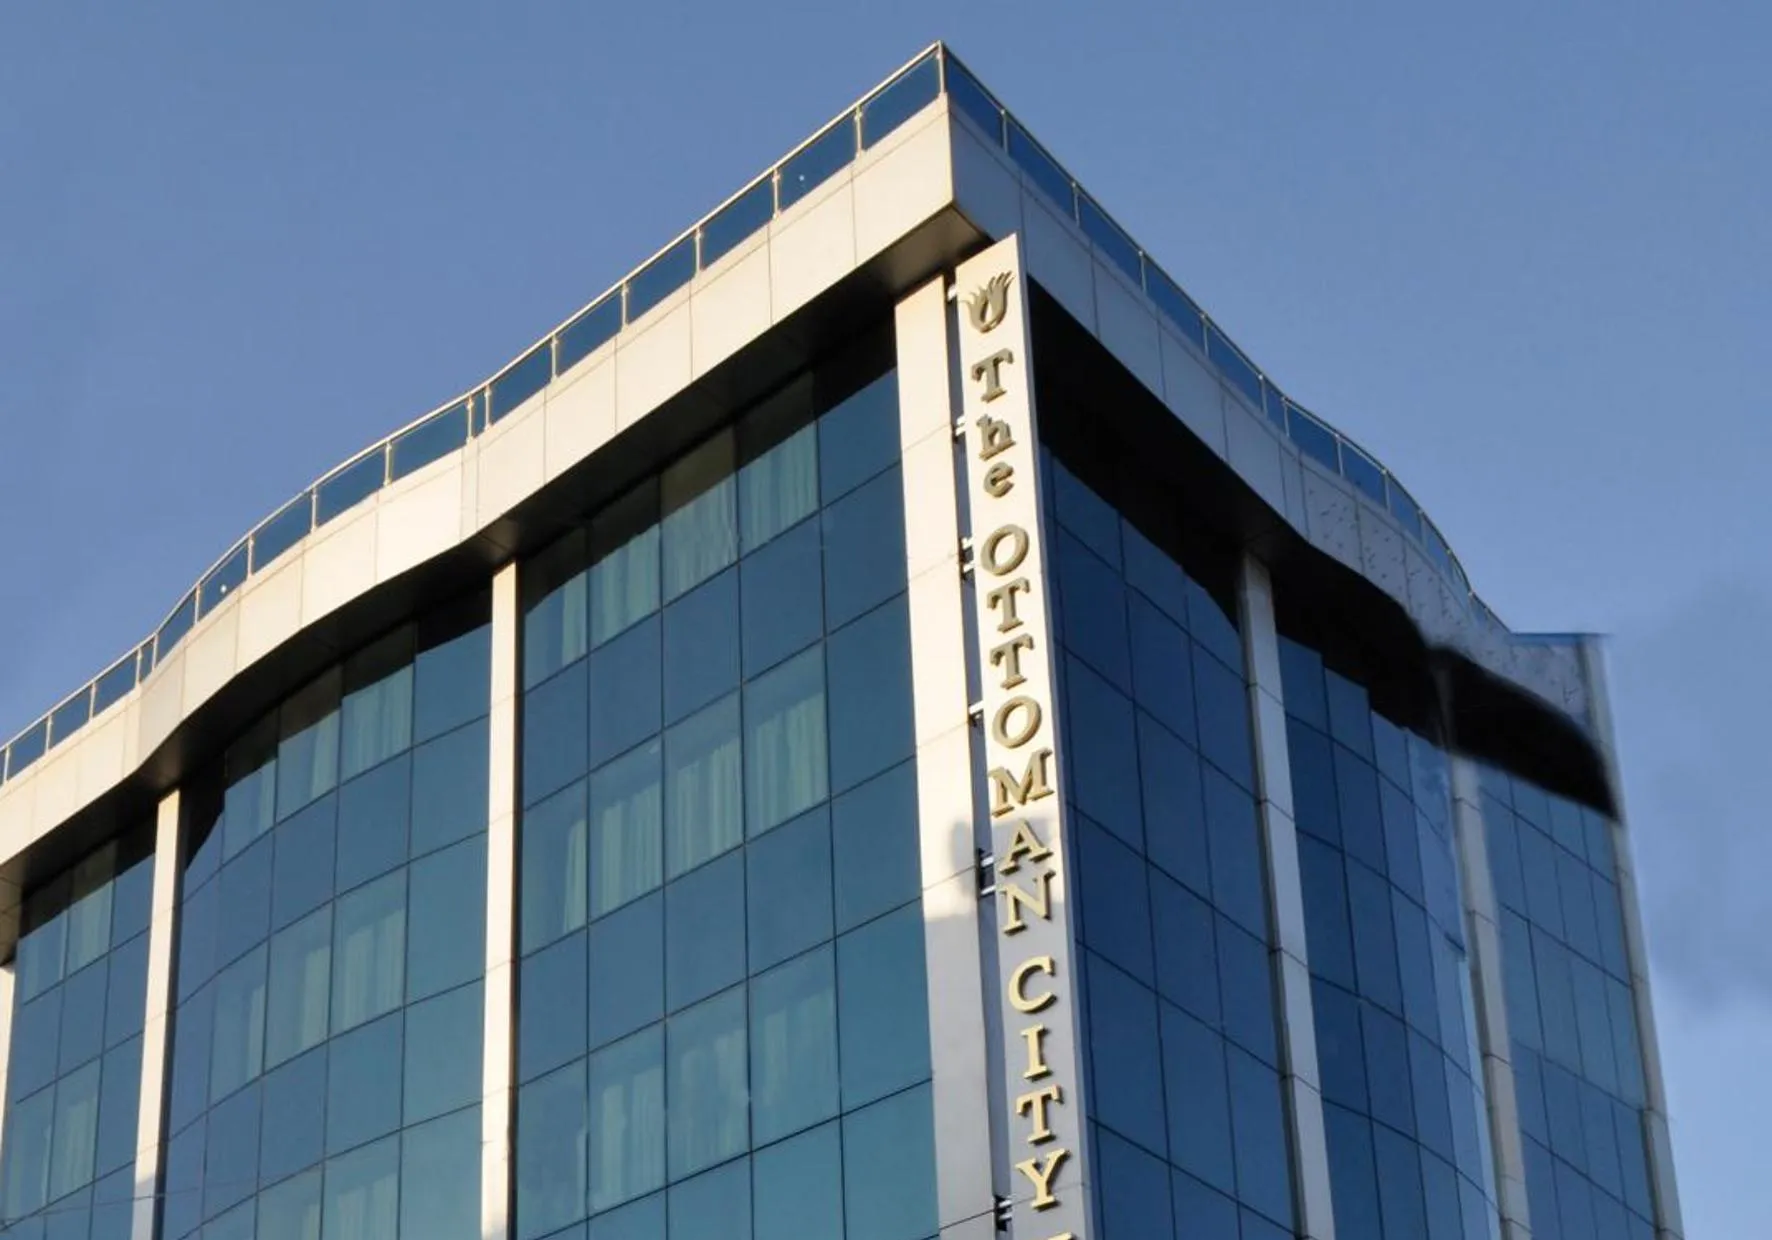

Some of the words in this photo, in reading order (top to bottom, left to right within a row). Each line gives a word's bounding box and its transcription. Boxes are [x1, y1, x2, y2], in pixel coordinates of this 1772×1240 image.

[971, 348, 1015, 499] The
[979, 523, 1055, 934] OTTOMAN
[1009, 954, 1070, 1210] CITY
